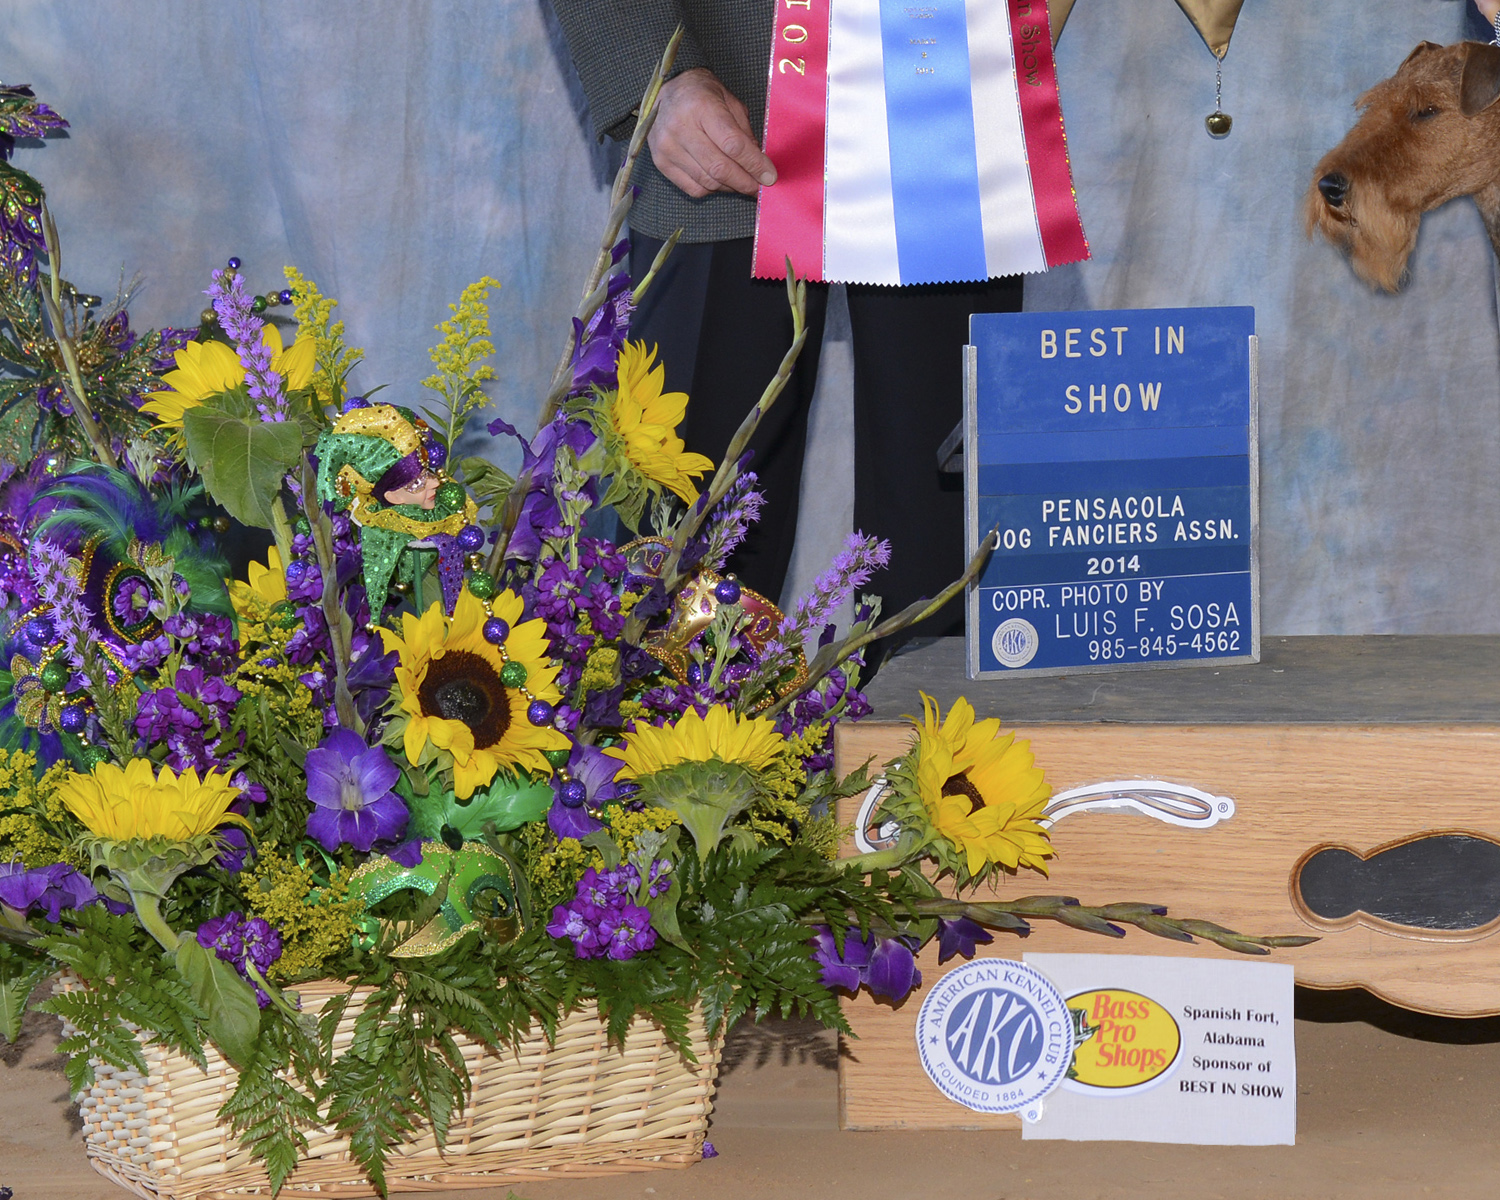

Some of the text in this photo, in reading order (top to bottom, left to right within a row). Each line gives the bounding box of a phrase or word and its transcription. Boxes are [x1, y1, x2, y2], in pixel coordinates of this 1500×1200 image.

[1020, 23, 1042, 87] Show
[1041, 325, 1185, 359] BEST IN
[1064, 382, 1162, 414] SHOW
[1042, 495, 1185, 523] PENSACOLA
[1049, 522, 1158, 547] FANCIERS
[1174, 519, 1239, 541] ASSN.
[1087, 555, 1140, 575] 2014
[992, 580, 1164, 612] COPR. PHOTO BY
[1055, 602, 1240, 638] LUIS F. SOSA
[1088, 630, 1240, 661] 985-845-4562
[930, 968, 1062, 1064] AMERICAN KENNEL CLUB
[1091, 994, 1150, 1020] Bass
[1183, 1004, 1280, 1026] Spanish Fort,
[948, 991, 1039, 1083] AKC
[1095, 1019, 1136, 1043] Pro
[1203, 1031, 1265, 1048] Alabama
[1096, 1042, 1167, 1073] Shops
[1192, 1055, 1272, 1073] Sponsor of
[936, 1061, 1024, 1102] FOUNDED 1884
[1179, 1079, 1284, 1099] BEST IN SHOW
